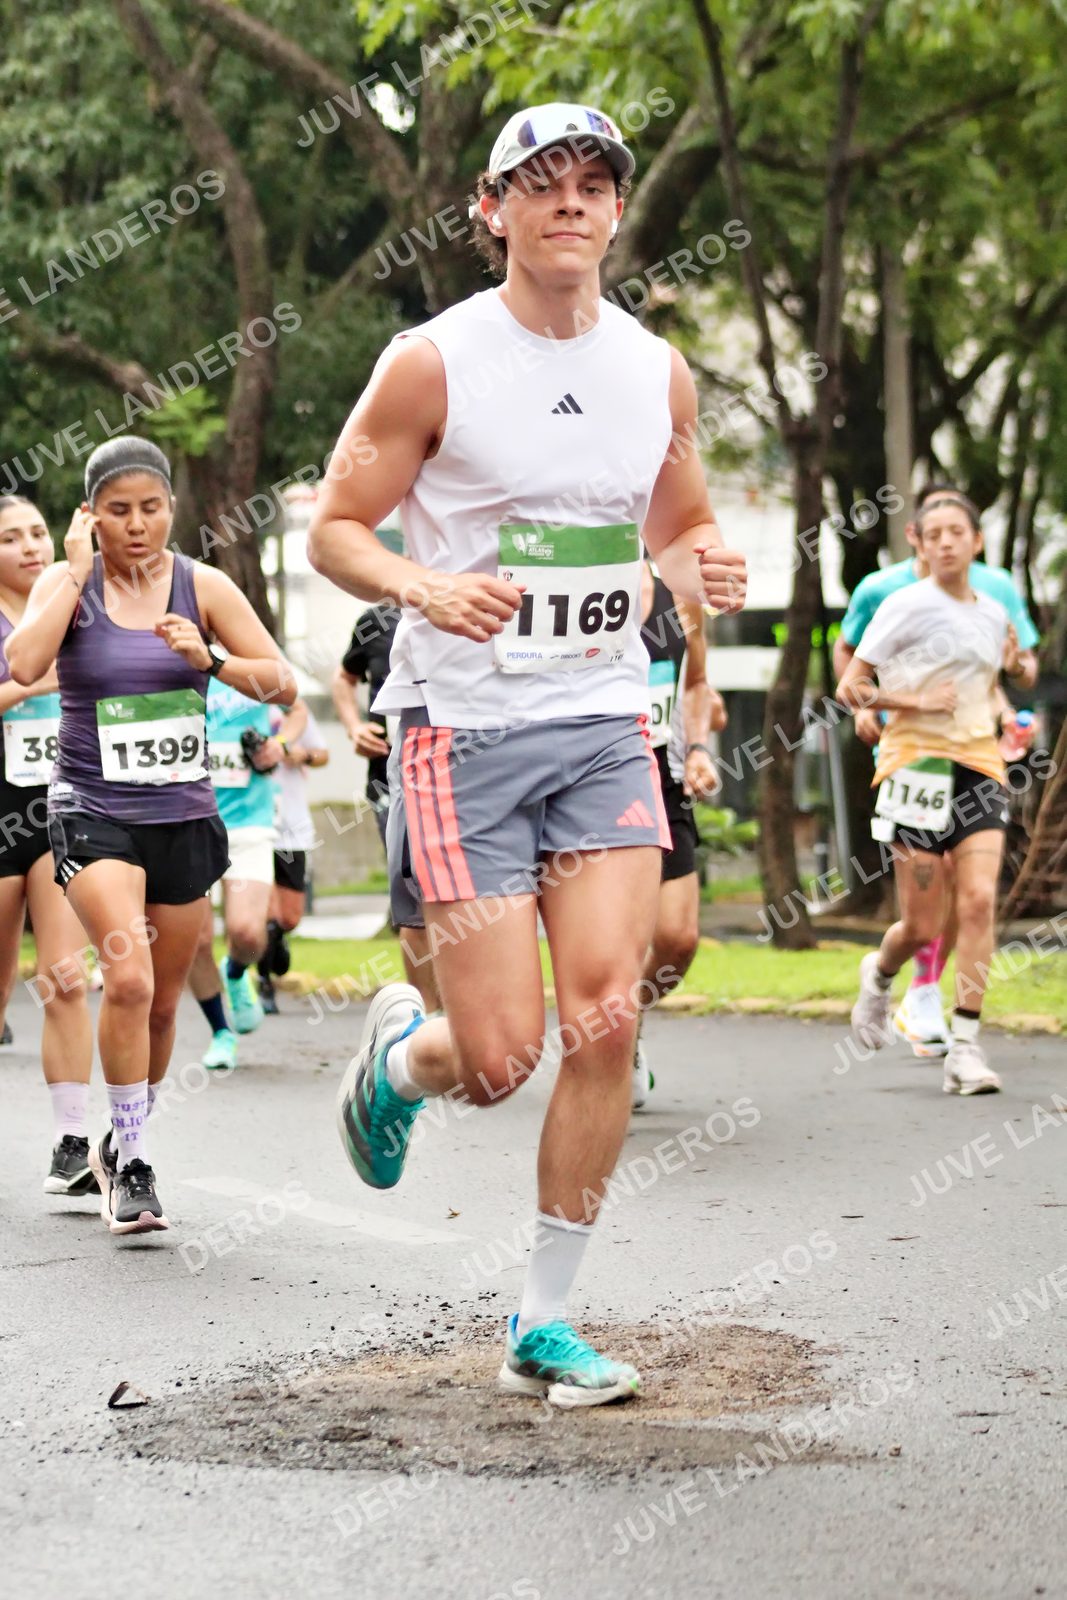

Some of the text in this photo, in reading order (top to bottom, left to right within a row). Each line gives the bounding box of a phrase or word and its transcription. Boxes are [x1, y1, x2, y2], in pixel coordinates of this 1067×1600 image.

[517, 590, 630, 637] 1169
[506, 651, 543, 660] PERDURA
[112, 735, 200, 770] 1399
[886, 777, 946, 810] 1146
[124, 1132, 139, 1142] IT
